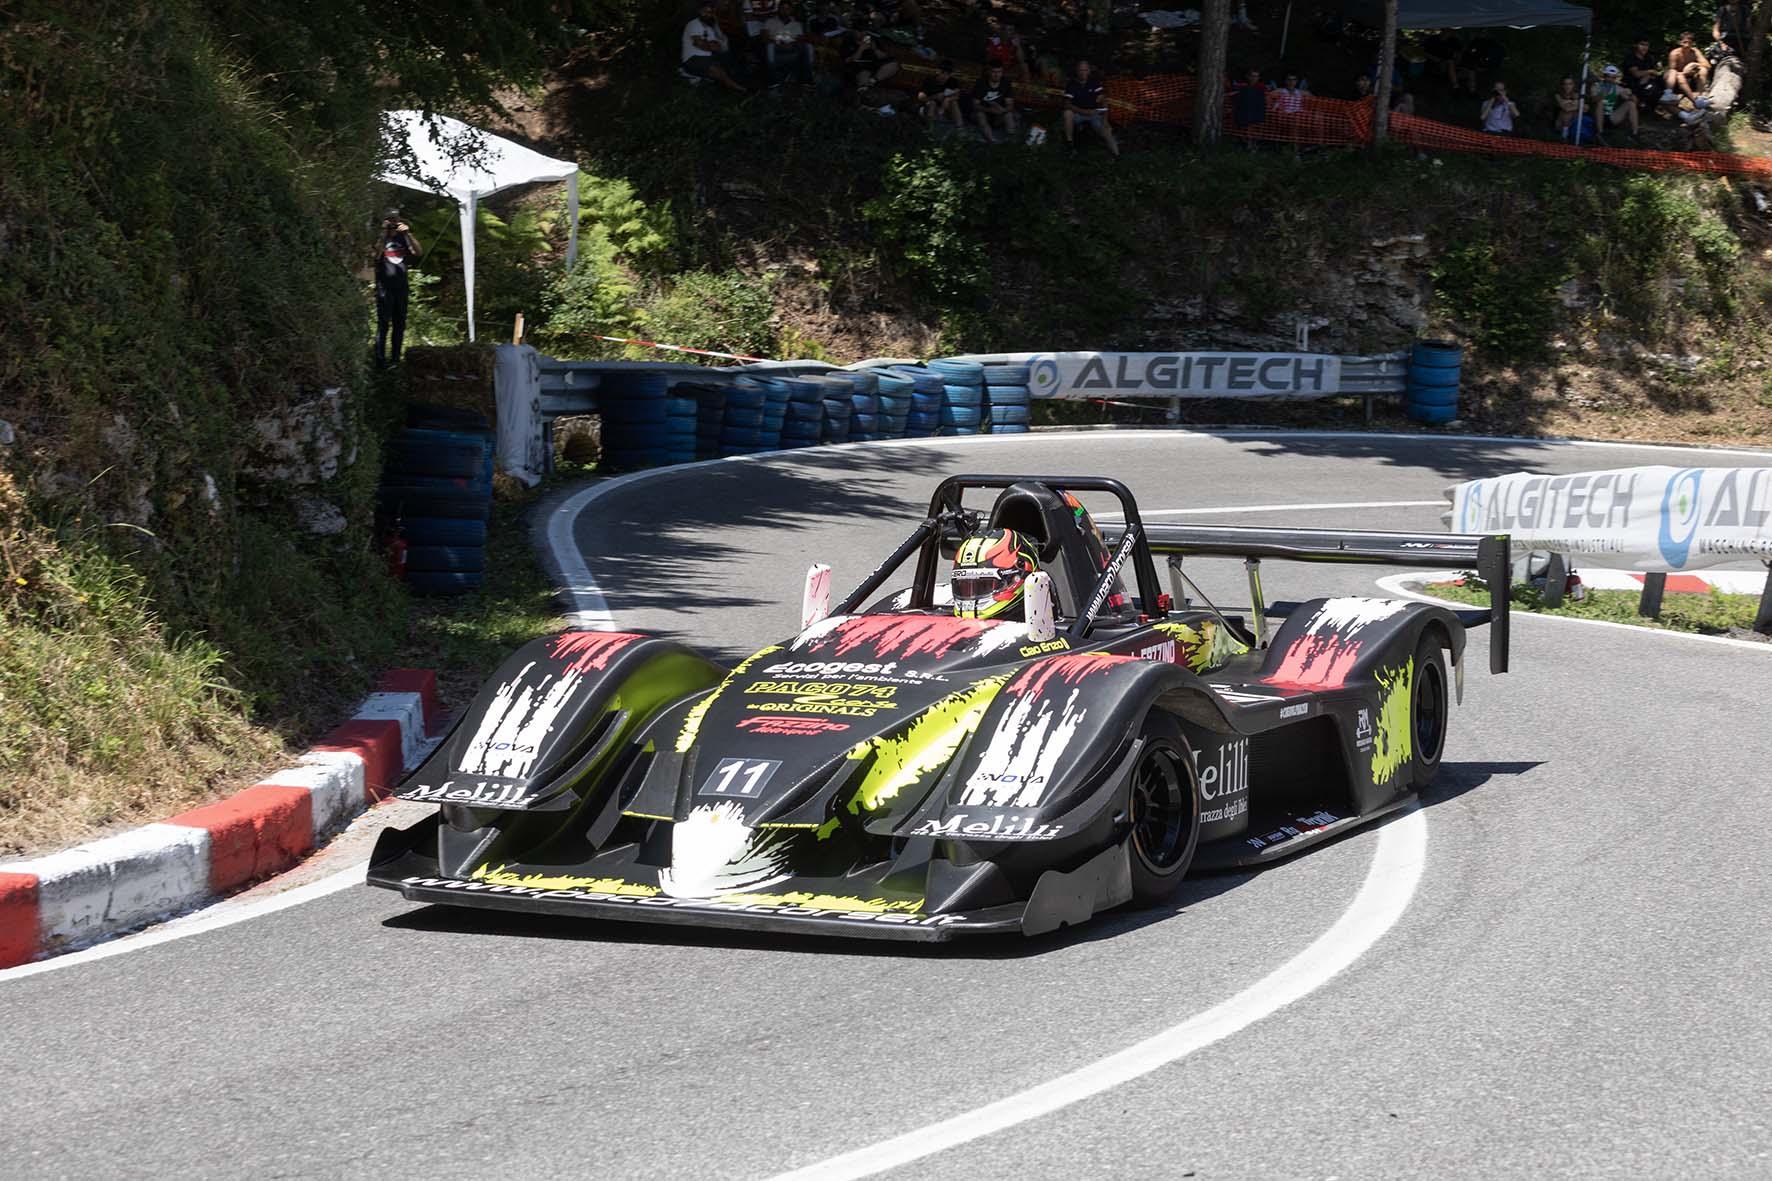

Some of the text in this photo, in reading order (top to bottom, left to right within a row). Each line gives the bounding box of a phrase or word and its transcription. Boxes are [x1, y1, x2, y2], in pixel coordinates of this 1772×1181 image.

[1072, 355, 1324, 391] ALGITECH
[1486, 472, 1639, 530] ALGITECH
[1704, 468, 1772, 528] AL
[1087, 533, 1136, 622] wwwpaco74corseit
[1020, 646, 1041, 657] Ciao
[763, 661, 898, 675] Ecogest
[821, 673, 845, 681] per
[848, 673, 923, 685] l'ambiente
[744, 681, 898, 698] PACO74
[716, 760, 770, 794] 11
[1191, 736, 1249, 801] elilli
[402, 781, 539, 804] Melilli
[914, 814, 1064, 837] Melilli
[1200, 808, 1223, 824] rrazza
